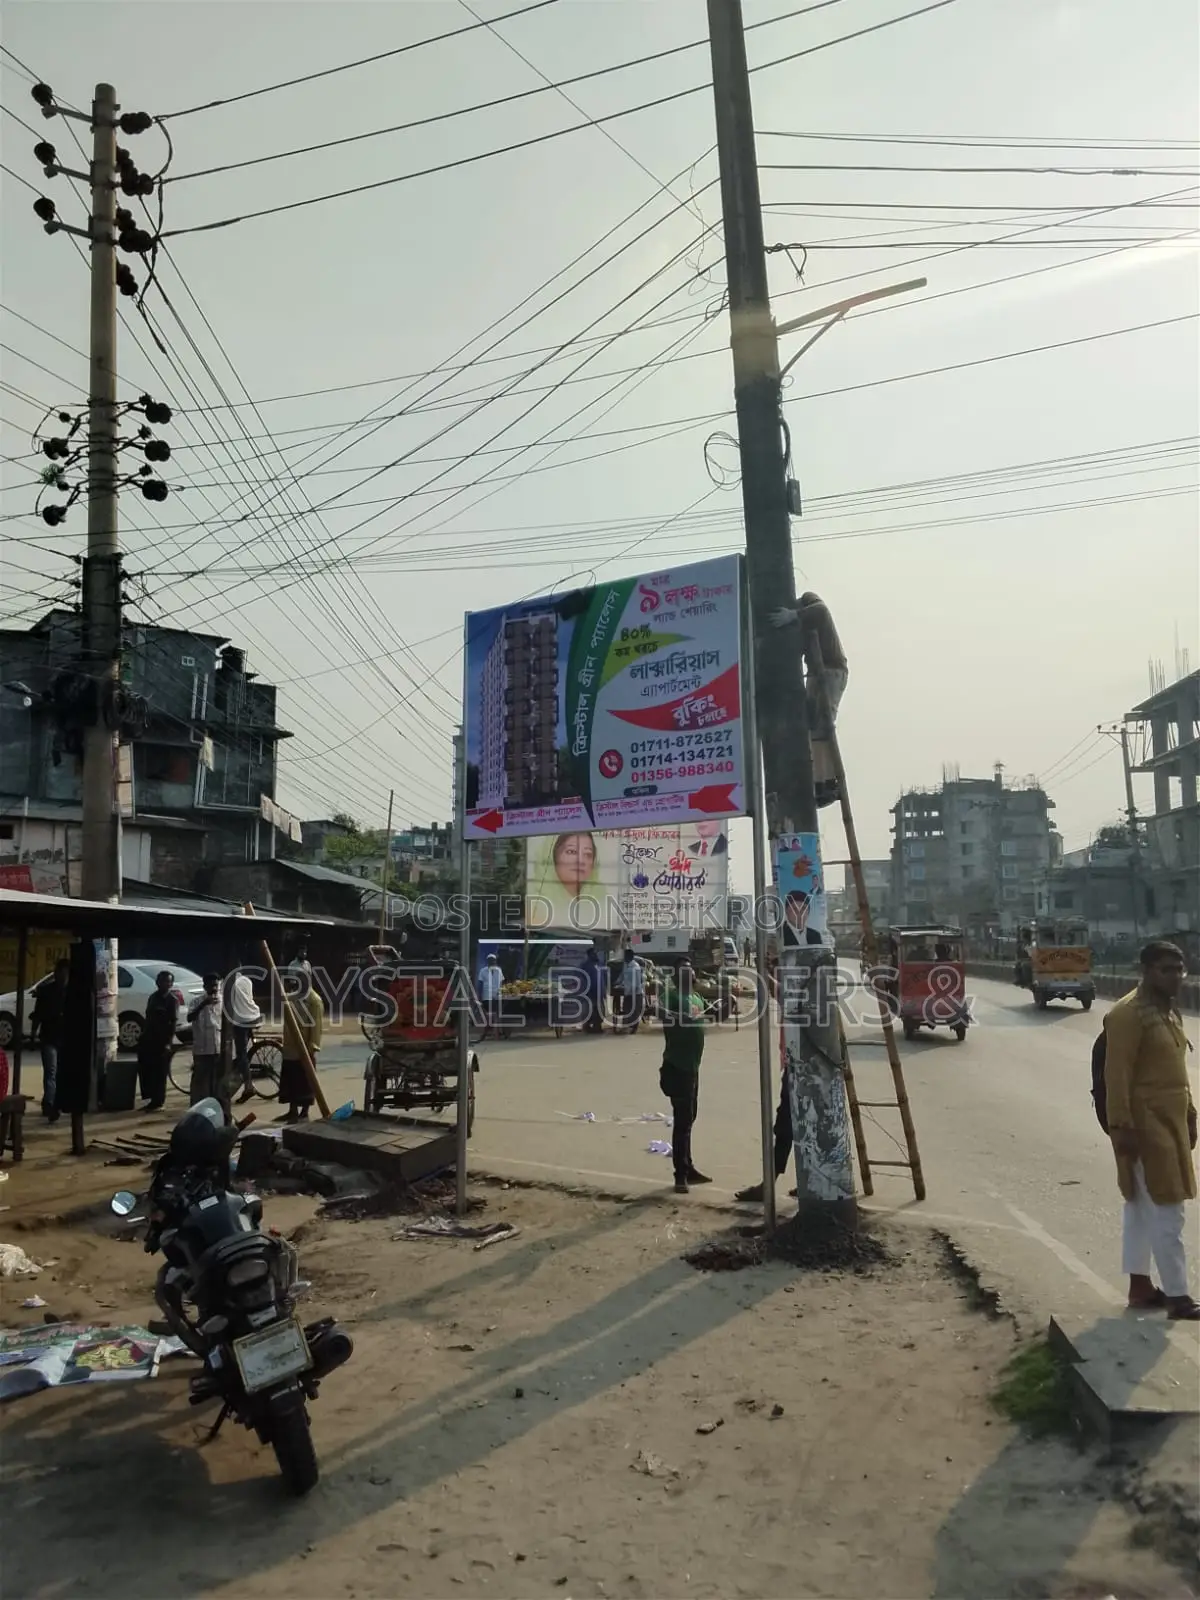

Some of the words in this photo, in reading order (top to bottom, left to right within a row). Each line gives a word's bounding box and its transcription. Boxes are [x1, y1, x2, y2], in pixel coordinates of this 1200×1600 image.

[638, 584, 661, 614] ৯
[663, 584, 699, 606] লক্ষ
[578, 655, 598, 688] গ্রীন
[590, 589, 621, 648] প্যালেস
[629, 650, 720, 680] লাক্সারিয়াস
[671, 694, 718, 727] বুকিং
[630, 745, 734, 768] 01714-134721
[631, 761, 735, 784] 01356-988340
[652, 868, 708, 895] মোবারক
